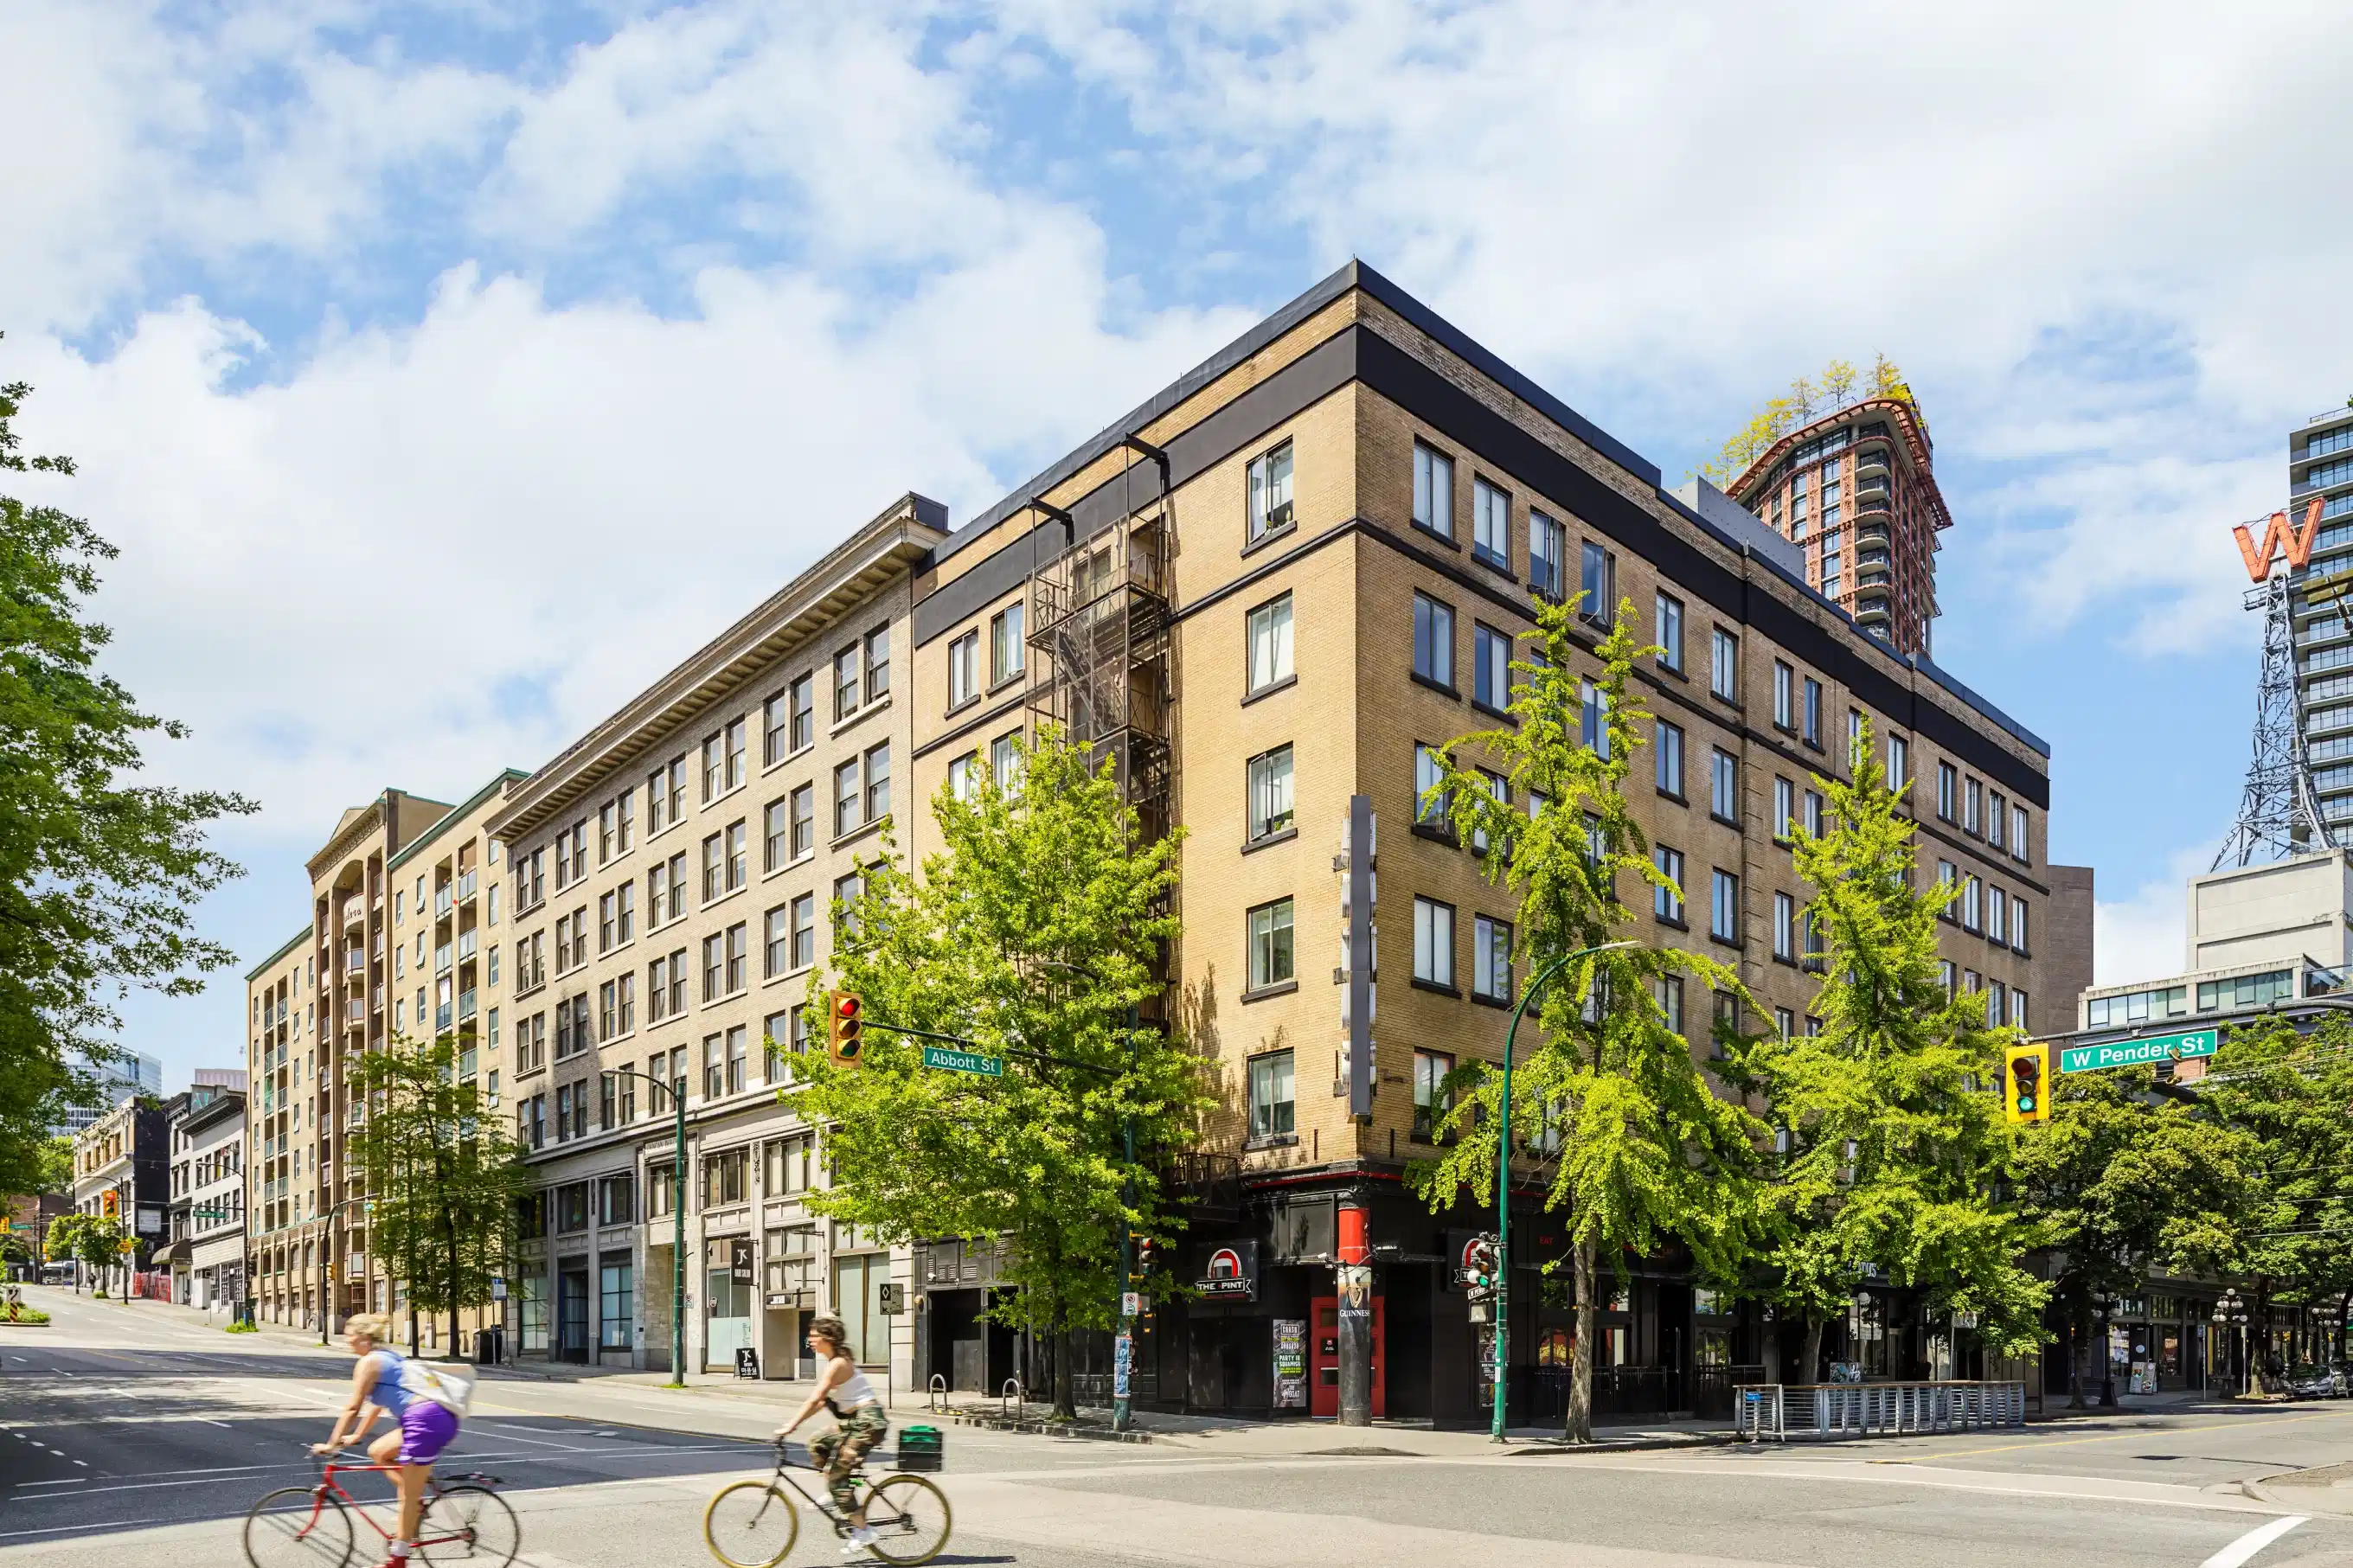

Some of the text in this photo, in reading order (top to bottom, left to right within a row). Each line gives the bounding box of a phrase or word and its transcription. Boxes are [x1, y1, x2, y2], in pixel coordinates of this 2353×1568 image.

[2233, 496, 2326, 583] W
[931, 1051, 996, 1072] Abbott St
[2073, 1036, 2205, 1067] W Pender St
[1221, 1281, 1242, 1290] PINT
[1339, 1309, 1370, 1317] GUINNESS
